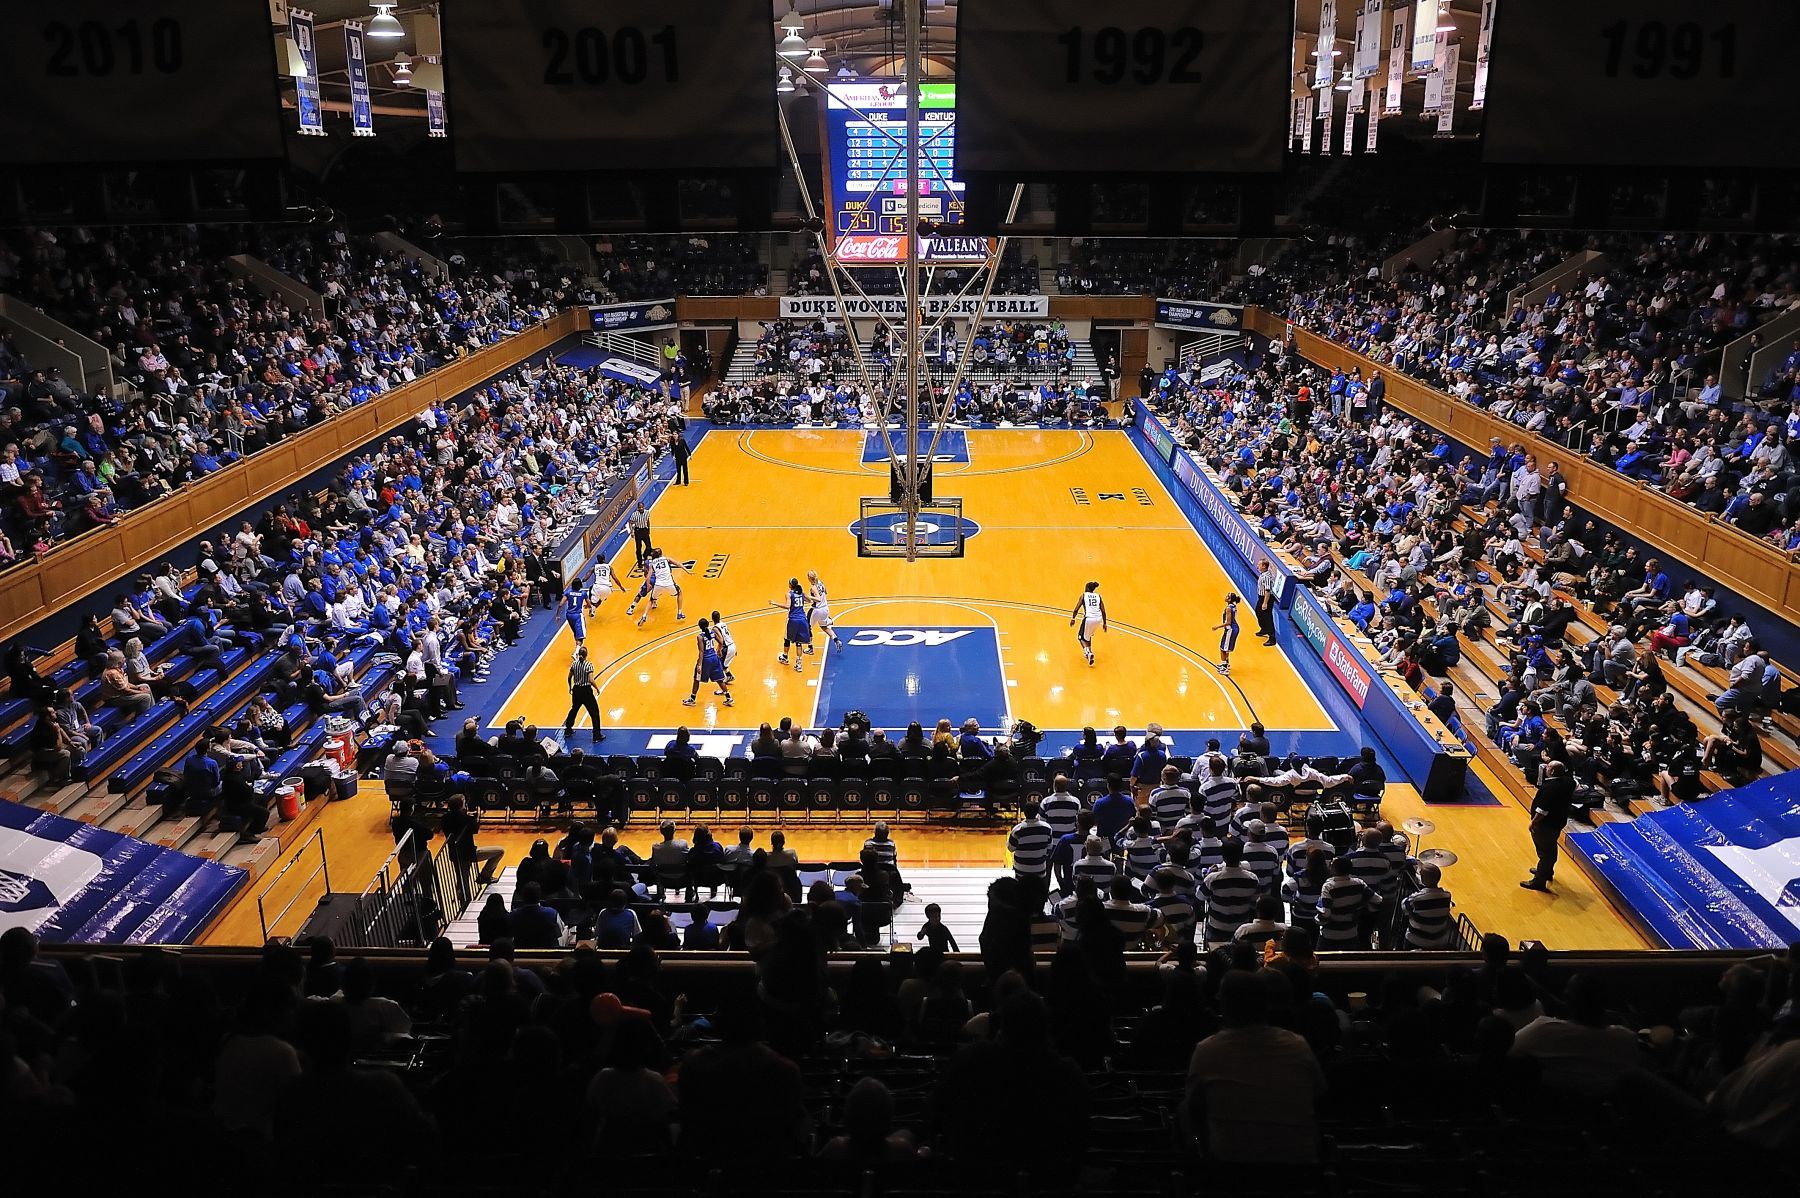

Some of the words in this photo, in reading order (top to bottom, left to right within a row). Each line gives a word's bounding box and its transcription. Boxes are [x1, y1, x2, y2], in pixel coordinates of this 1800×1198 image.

[43, 18, 182, 77] 2010
[1601, 20, 1736, 79] 1991
[543, 25, 679, 85] 2001
[1058, 26, 1203, 85] 1992
[868, 112, 888, 121] DUKE
[845, 201, 868, 210] DUKE
[850, 214, 870, 229] 34
[930, 238, 988, 252] VALEANT
[790, 301, 837, 313] DUKE
[1190, 472, 1210, 504] DUKE
[1207, 492, 1256, 565] BASKETBALL
[656, 561, 667, 570] 43
[794, 597, 803, 608] 31
[1089, 599, 1097, 607] 12
[705, 639, 715, 650] 20
[848, 630, 975, 646] ACC
